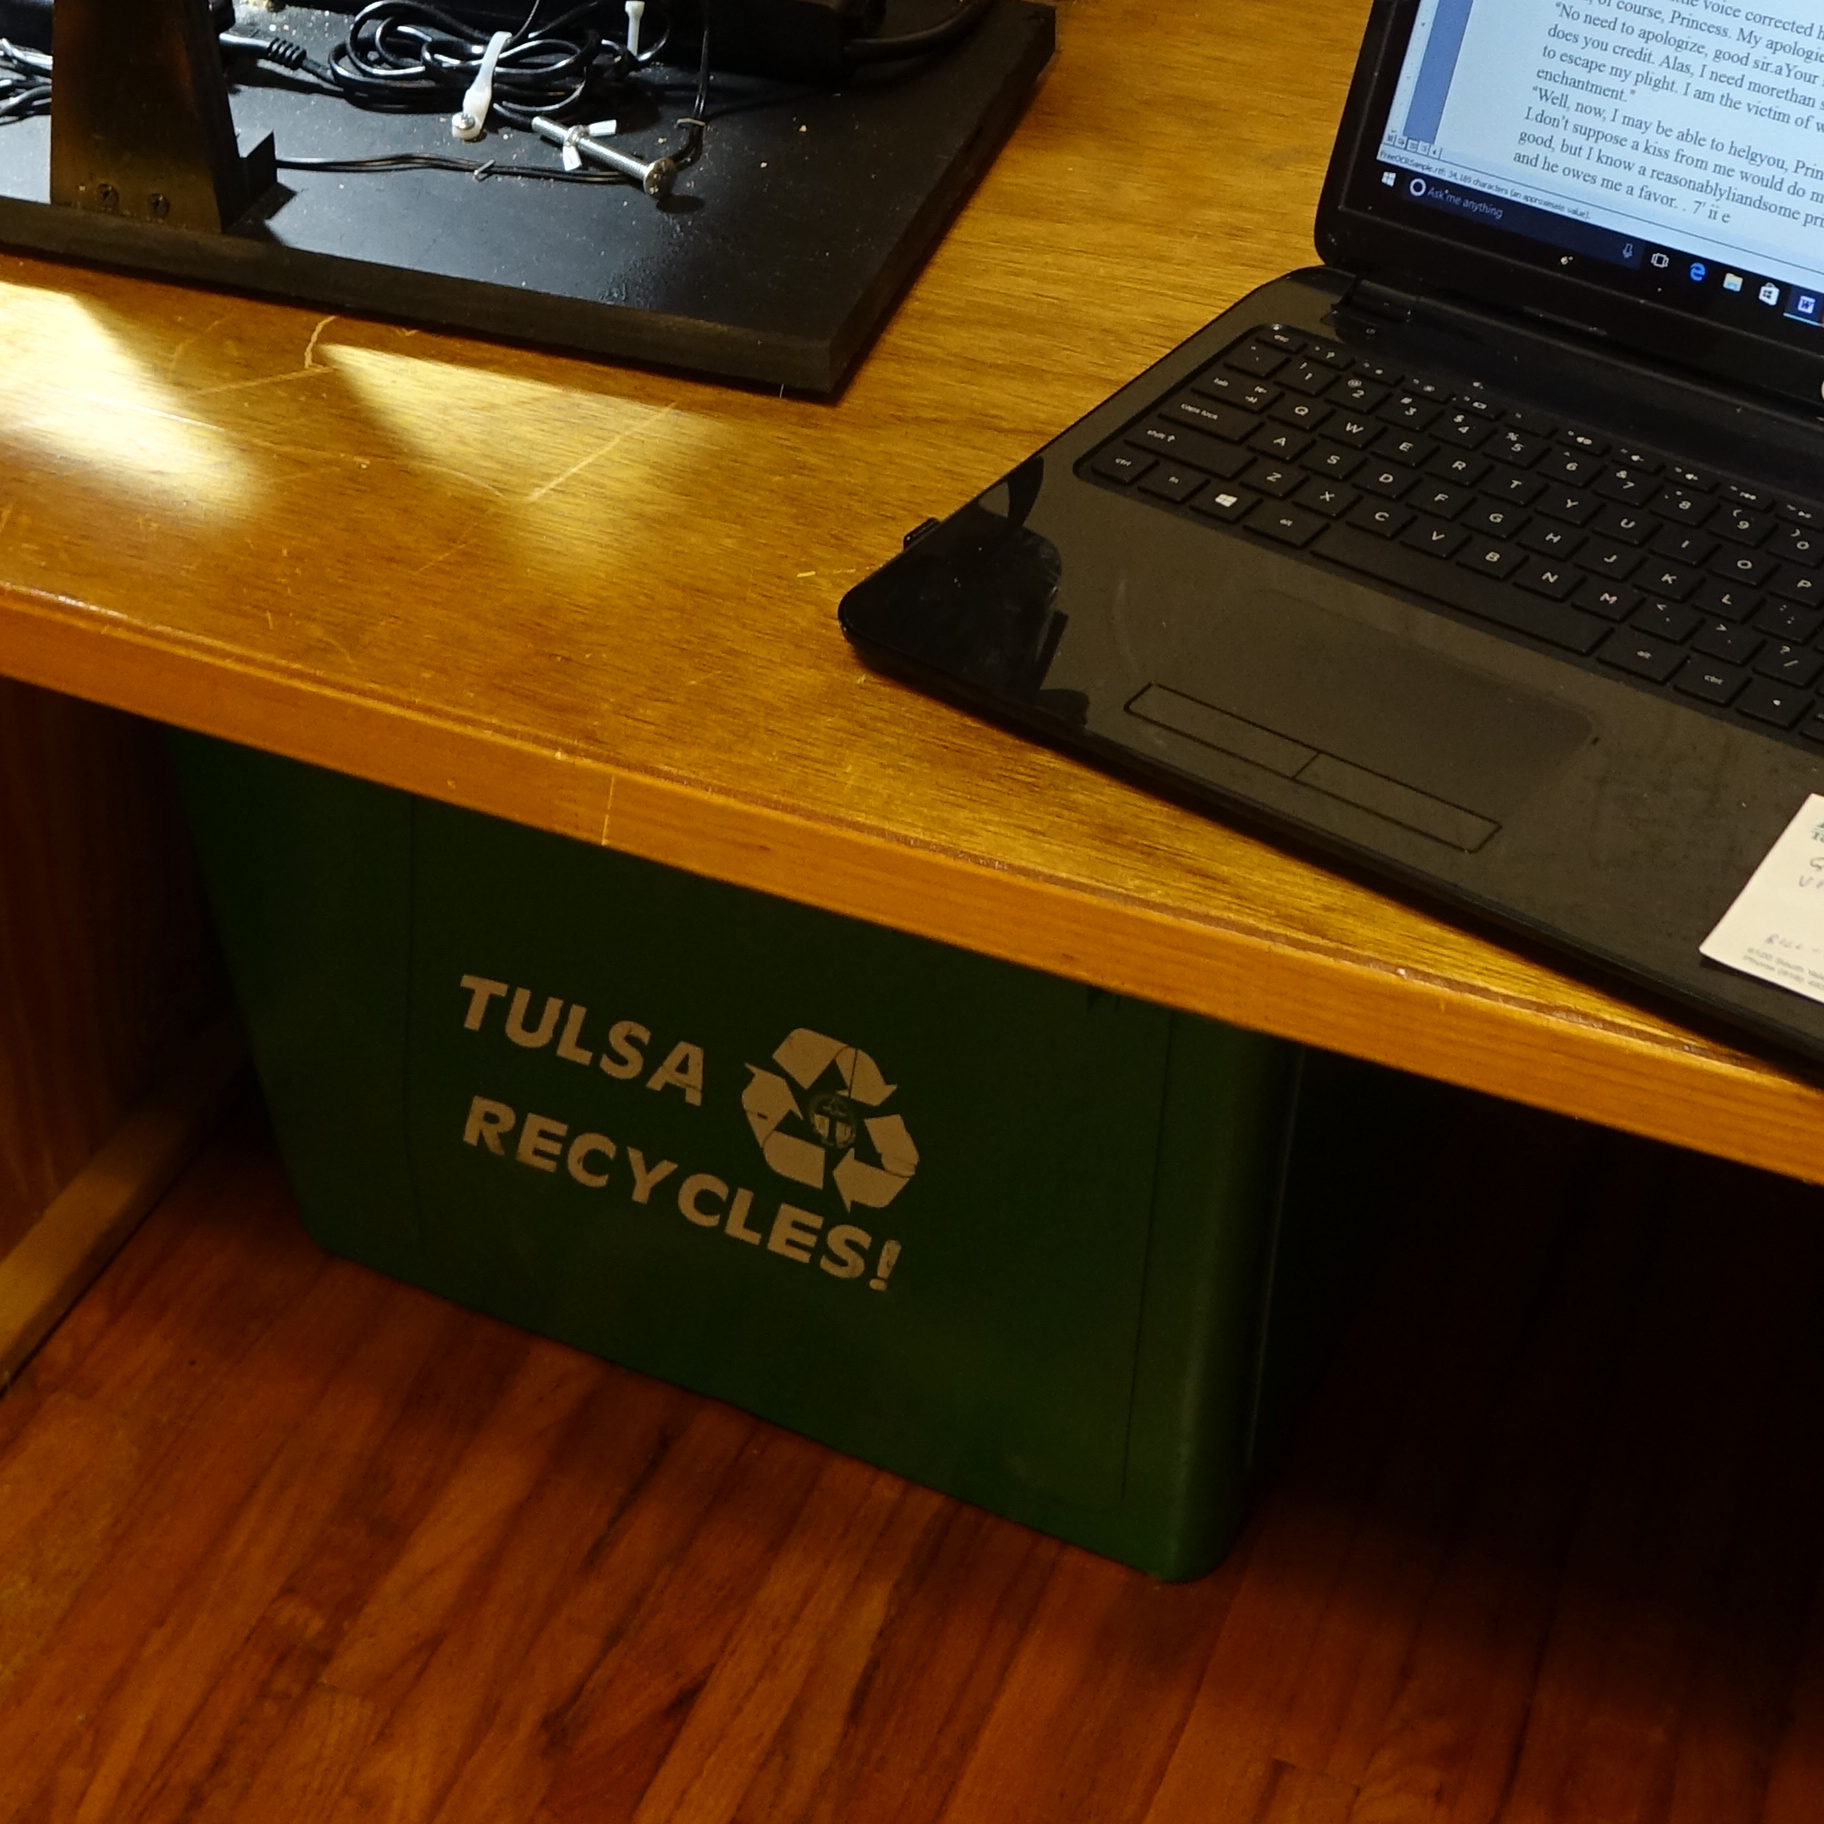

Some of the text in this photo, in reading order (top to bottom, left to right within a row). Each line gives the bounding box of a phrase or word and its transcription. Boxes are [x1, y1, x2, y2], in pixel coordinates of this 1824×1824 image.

[1743, 10, 1815, 38] corrected
[1428, 185, 1504, 220] Ask me anything
[458, 973, 706, 1107] TULSA
[462, 1095, 902, 1291] RECYCLES!
